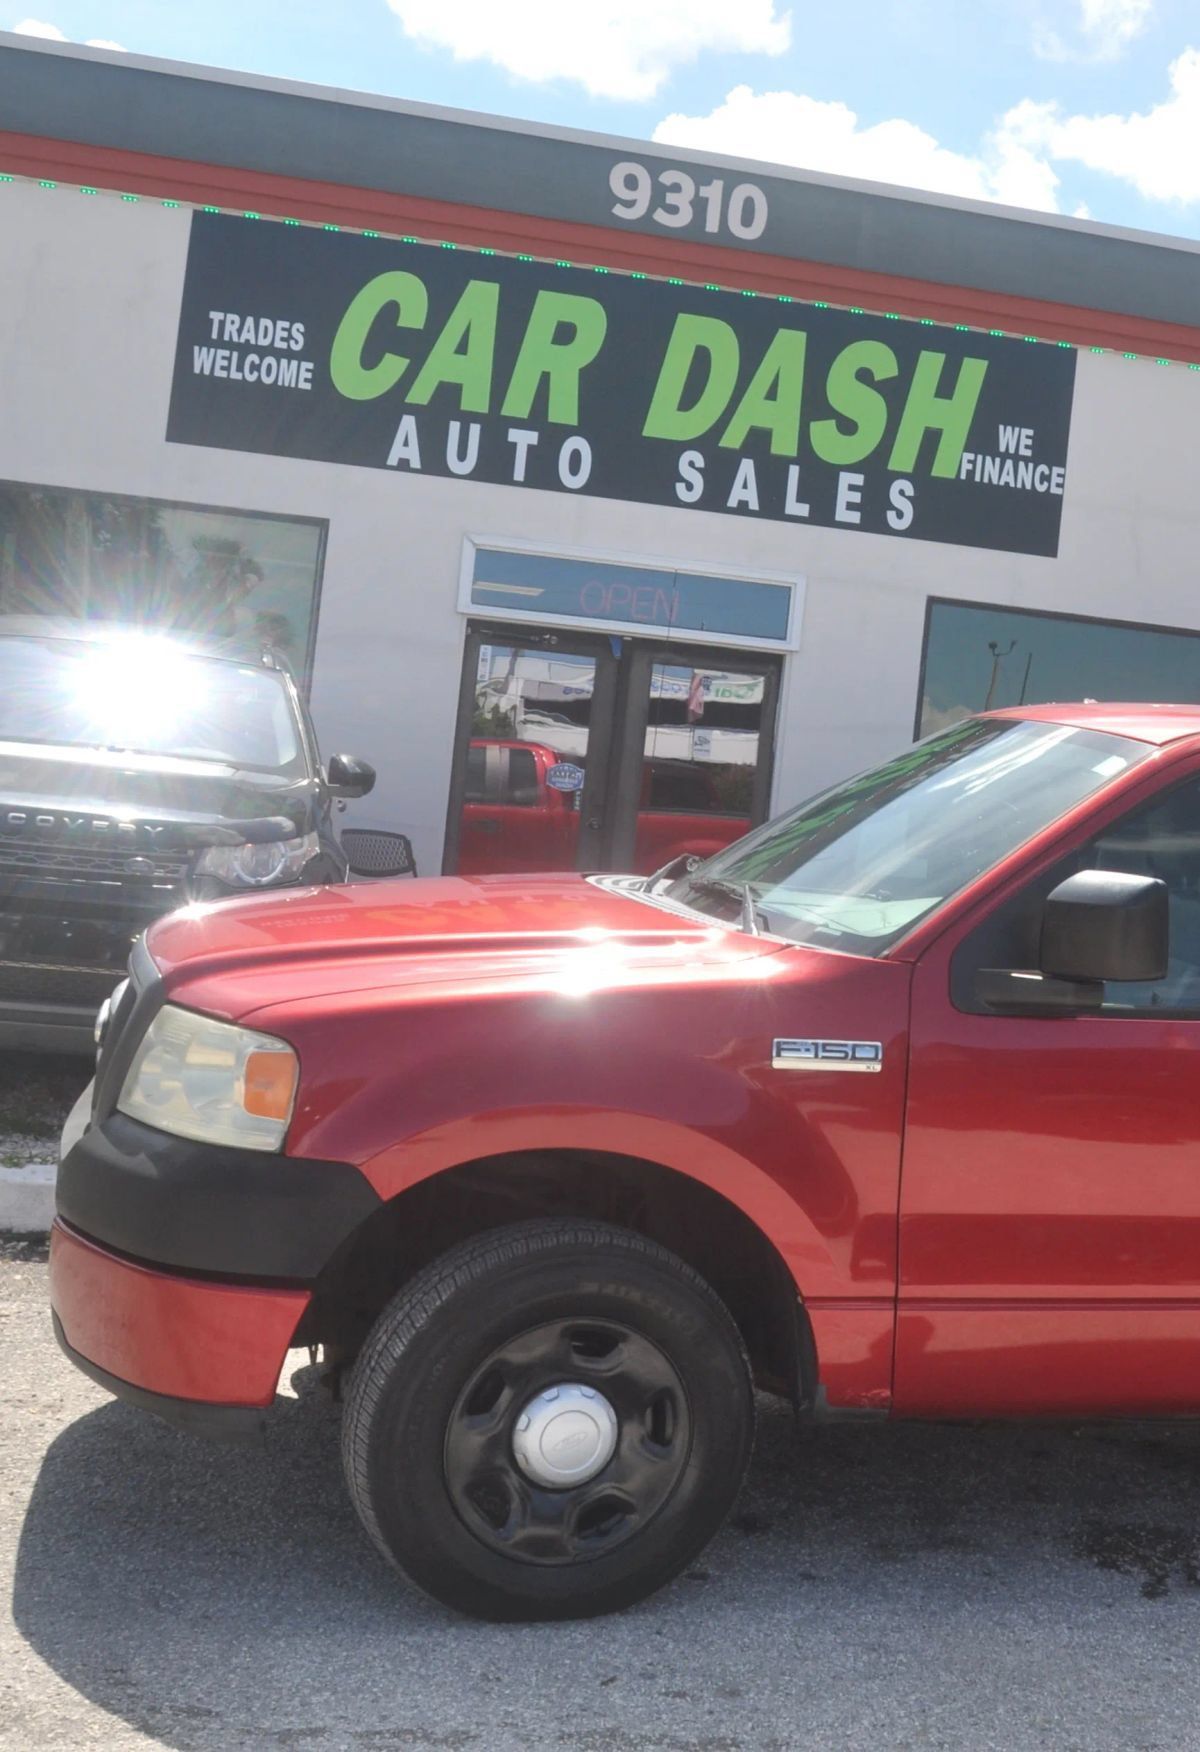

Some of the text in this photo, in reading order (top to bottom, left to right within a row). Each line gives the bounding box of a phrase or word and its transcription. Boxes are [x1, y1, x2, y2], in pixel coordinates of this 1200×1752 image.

[609, 161, 768, 240] 9310
[208, 311, 305, 351] TRADES
[192, 346, 314, 390] WELCOME
[330, 270, 989, 479] CAR DASH
[998, 424, 1034, 457] WE
[386, 414, 915, 531] AUTO SALES
[960, 453, 1065, 495] FINANCE
[580, 581, 681, 623] OPEN
